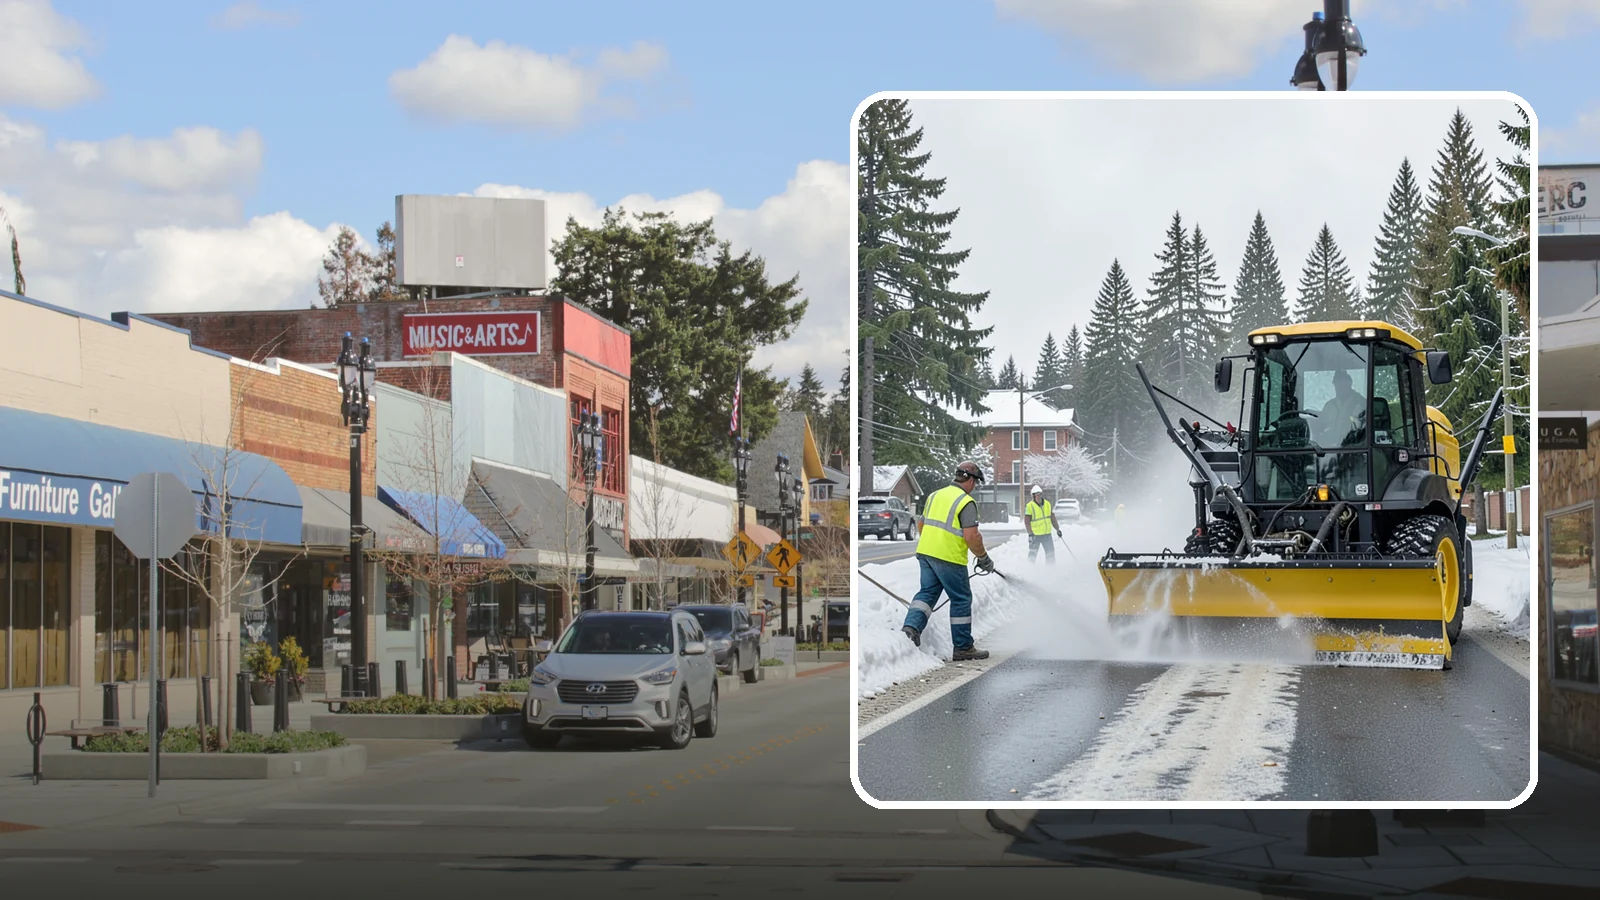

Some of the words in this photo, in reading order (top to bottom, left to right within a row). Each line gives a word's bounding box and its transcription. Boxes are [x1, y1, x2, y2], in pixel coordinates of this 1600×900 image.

[409, 322, 520, 349] MUSIC&ARTS
[1540, 427, 1578, 437] UGA
[0, 471, 80, 515] Furniture
